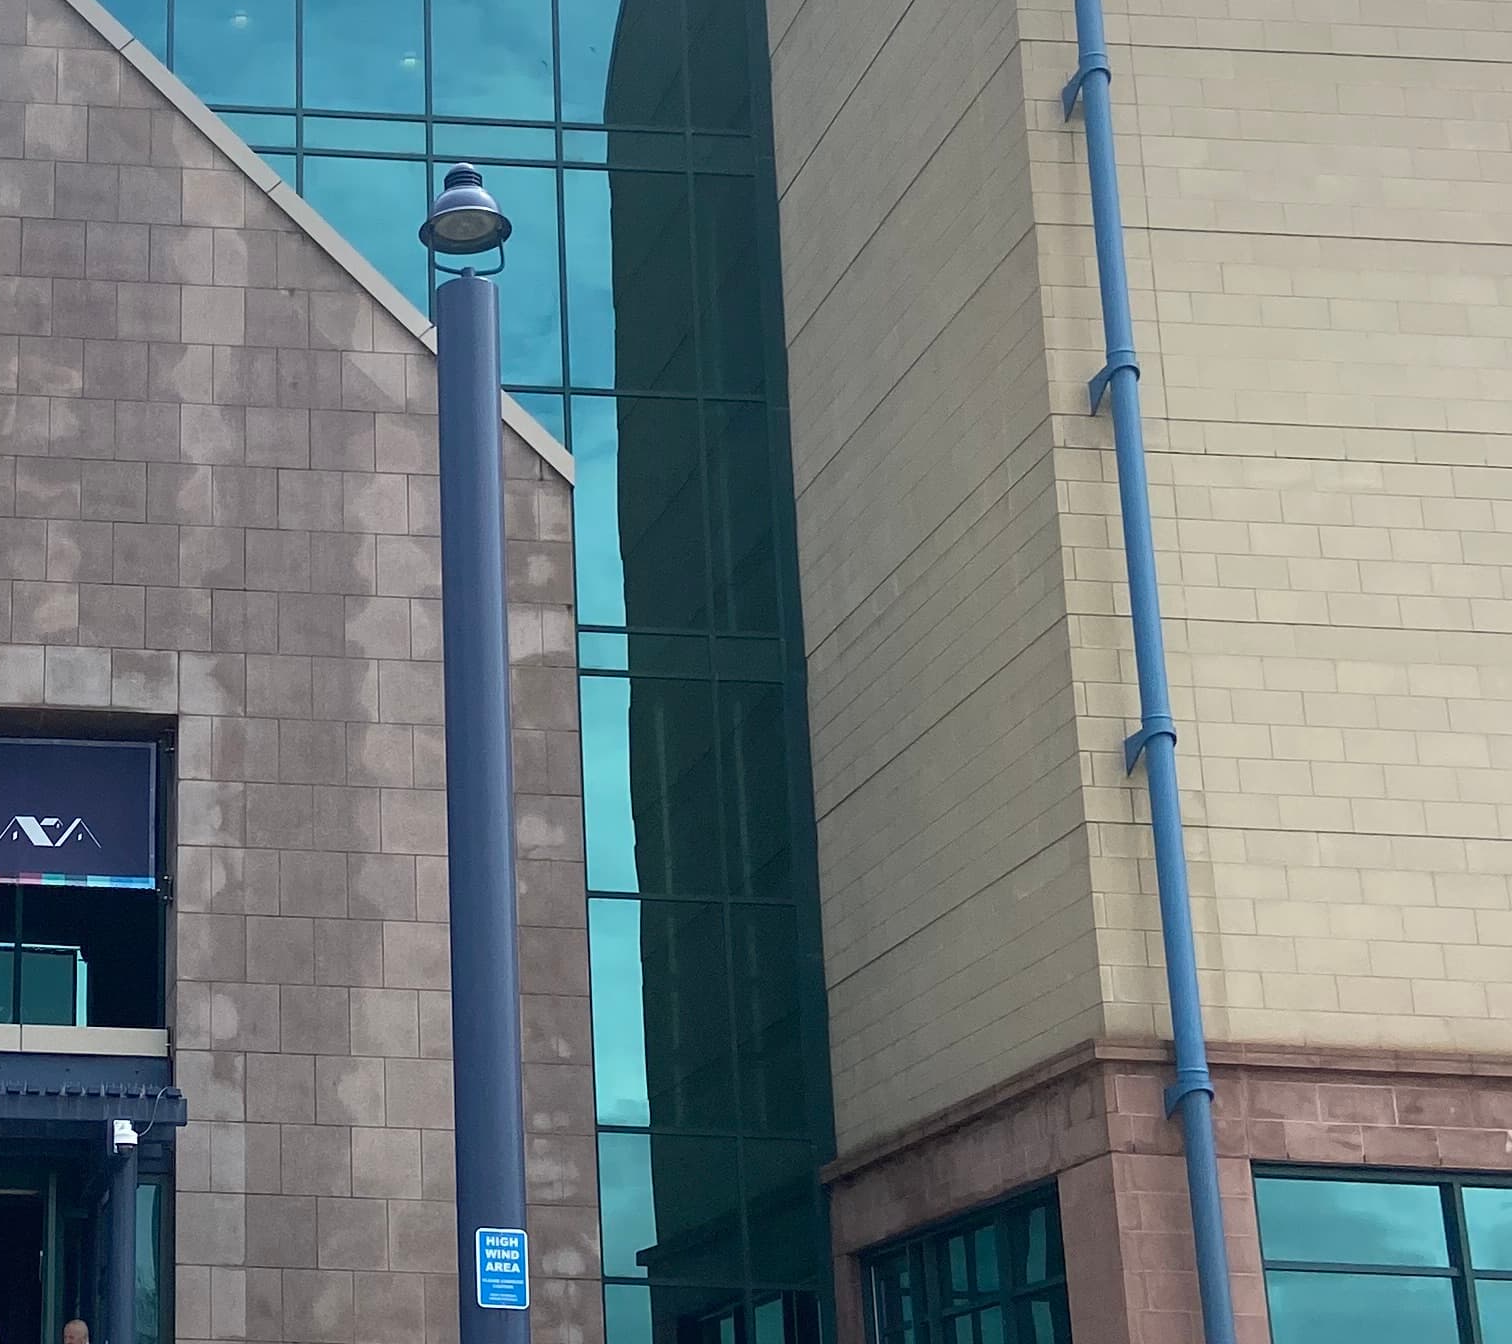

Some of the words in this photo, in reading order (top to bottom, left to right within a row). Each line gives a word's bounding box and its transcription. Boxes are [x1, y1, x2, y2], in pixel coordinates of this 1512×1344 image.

[485, 1236, 519, 1248] HIGH
[485, 1249, 520, 1260] WIND
[485, 1261, 521, 1273] AREA
